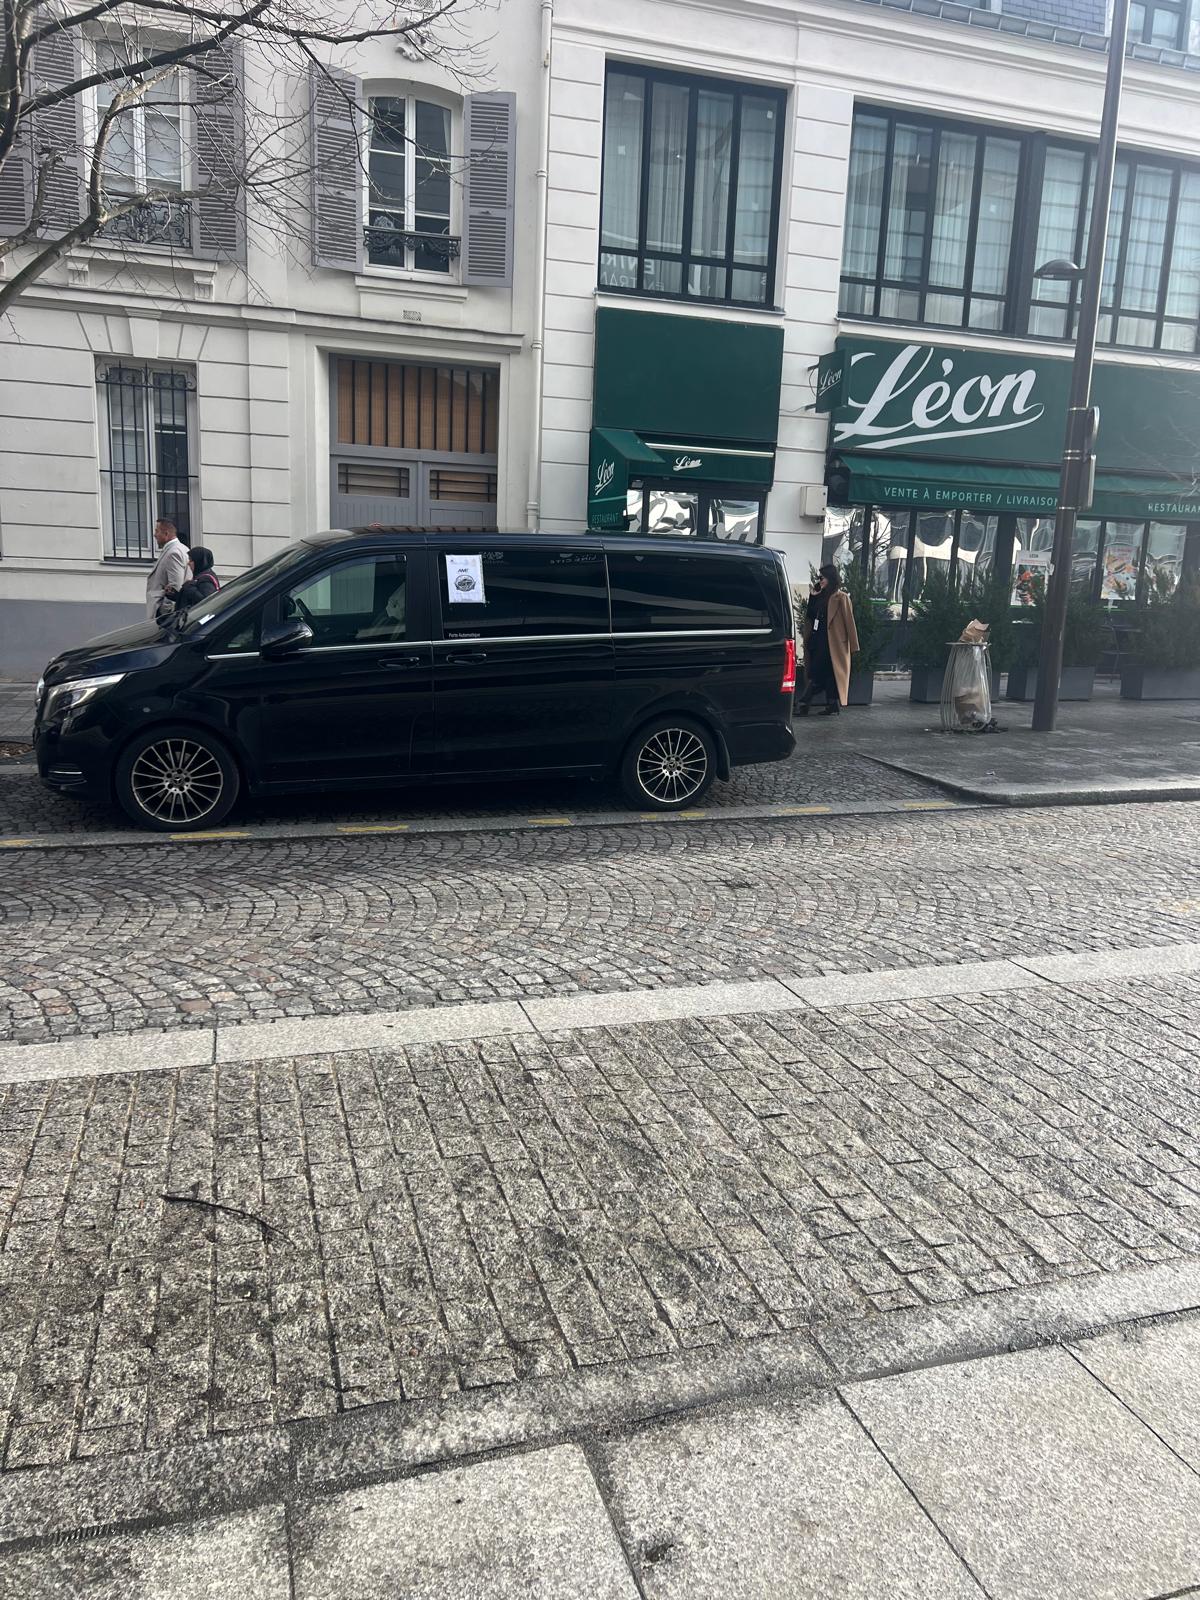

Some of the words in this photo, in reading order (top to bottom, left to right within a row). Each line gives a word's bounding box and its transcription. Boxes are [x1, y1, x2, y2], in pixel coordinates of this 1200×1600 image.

[833, 344, 1044, 449] Léon
[884, 486, 918, 499] VENTE
[923, 487, 931, 500] À
[935, 490, 992, 503] EMPORTER
[591, 512, 619, 524] RESTAURANT
